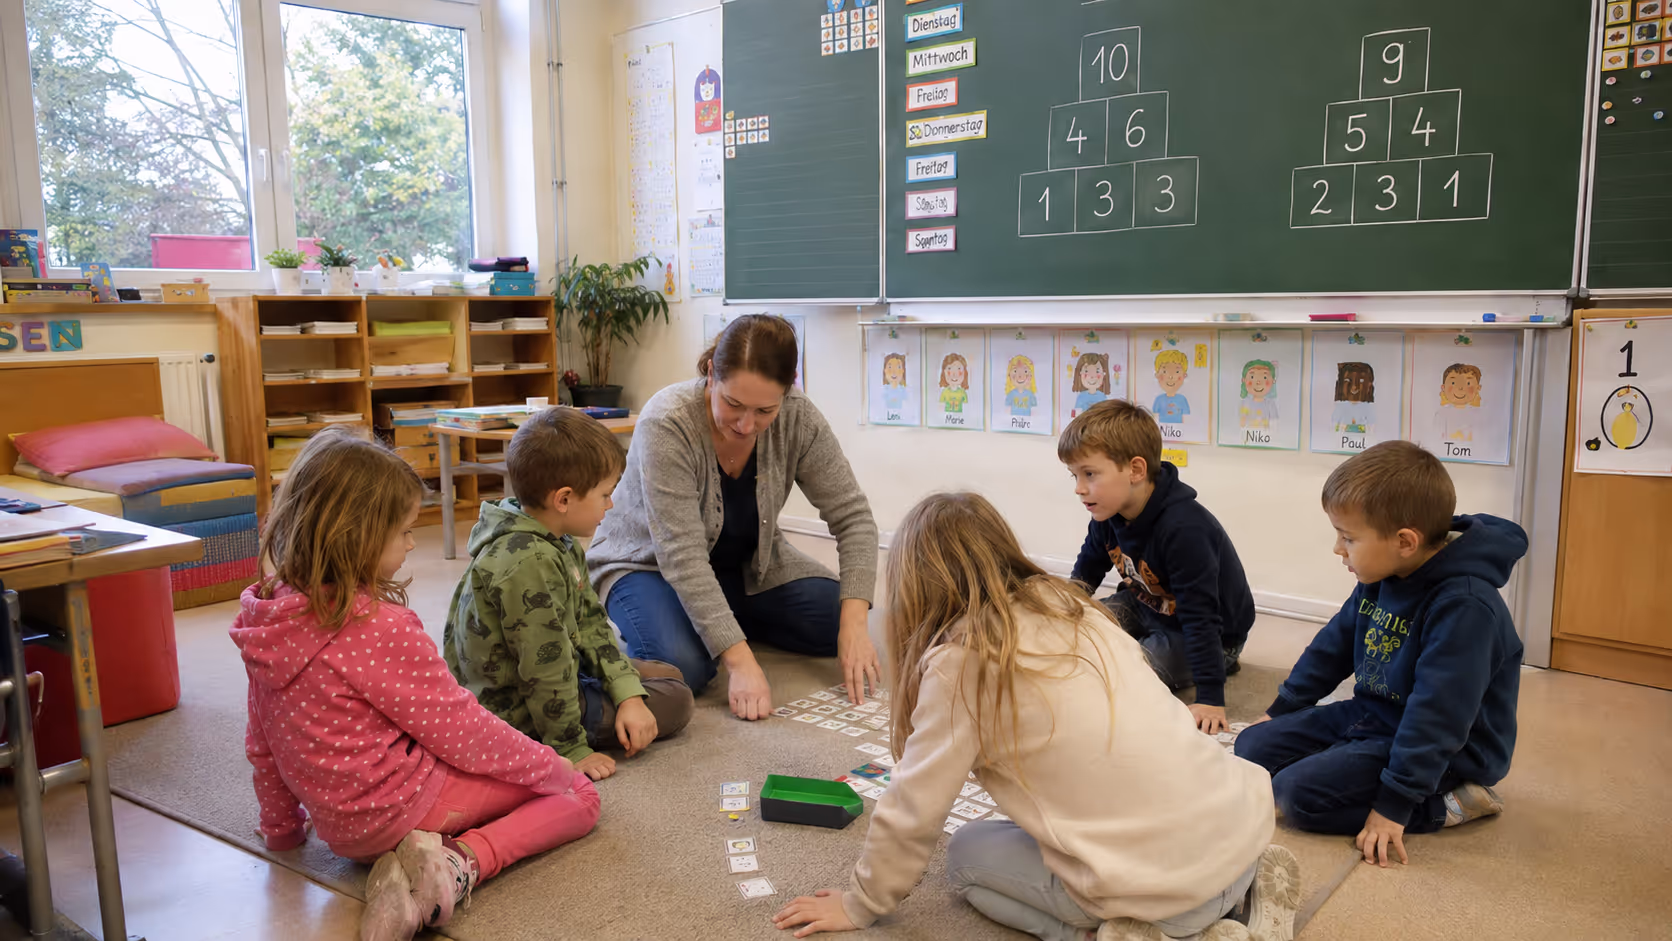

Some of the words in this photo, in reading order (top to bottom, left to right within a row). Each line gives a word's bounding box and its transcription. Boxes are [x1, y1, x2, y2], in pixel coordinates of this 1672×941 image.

[912, 14, 957, 33] Dienstag
[912, 45, 968, 69] Mittwoch
[1091, 42, 1129, 84] 10
[1381, 42, 1404, 84] 9
[923, 119, 984, 137] Donnerstag
[1065, 115, 1088, 155] 4
[1125, 108, 1146, 148] 6
[1344, 113, 1368, 152] 5
[1411, 106, 1437, 147] 4
[916, 160, 948, 176] Freitag
[1038, 186, 1050, 222] 1
[1094, 180, 1115, 217] 3
[1155, 175, 1176, 213] 3
[1310, 178, 1332, 215] 2
[1375, 174, 1398, 211] 3
[1443, 169, 1460, 208] 1
[0, 319, 83, 352] SEN
[1618, 340, 1638, 378] 1
[944, 414, 965, 425] Marie
[1160, 424, 1182, 438] Niko
[1246, 429, 1270, 443] Niko
[1341, 436, 1366, 449] Paul
[1444, 442, 1471, 456] Tom
